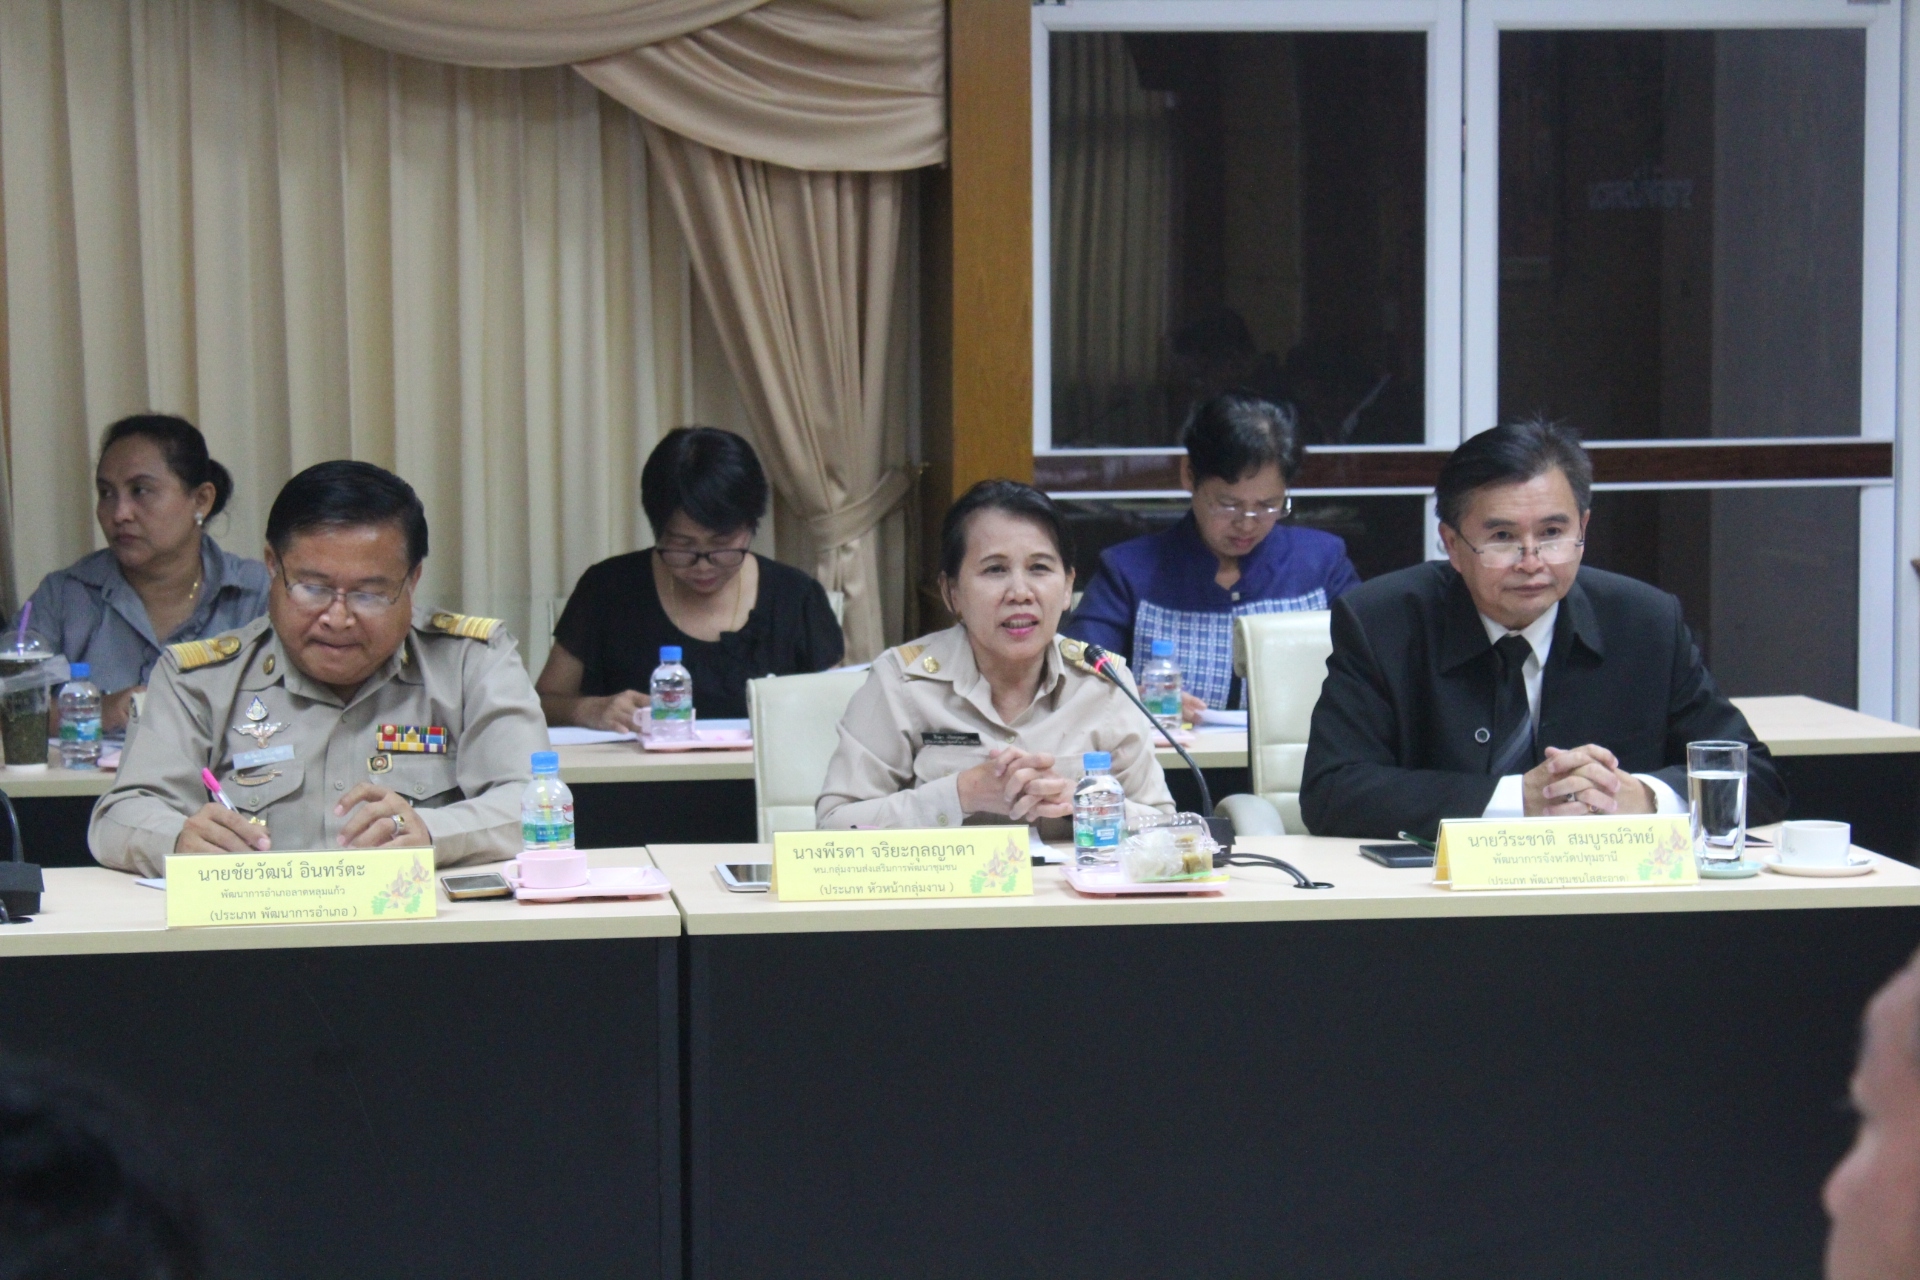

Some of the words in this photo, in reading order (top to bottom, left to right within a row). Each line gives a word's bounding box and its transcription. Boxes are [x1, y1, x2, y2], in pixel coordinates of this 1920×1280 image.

[1468, 829, 1556, 847] นายวีระชาติ
[1568, 826, 1655, 850] สมบูรณ์วิทย์
[793, 842, 864, 860] นางพีรดา
[871, 841, 975, 862] จริยะกุลญาดา
[1493, 850, 1618, 866] พัฒนาการจังหวัดปทุมธานี
[198, 860, 293, 882] นายชัยวัฒน์
[300, 859, 366, 878] อินทร์ตะ
[819, 884, 864, 896] (ประเภท
[210, 909, 257, 922] (ประเภท
